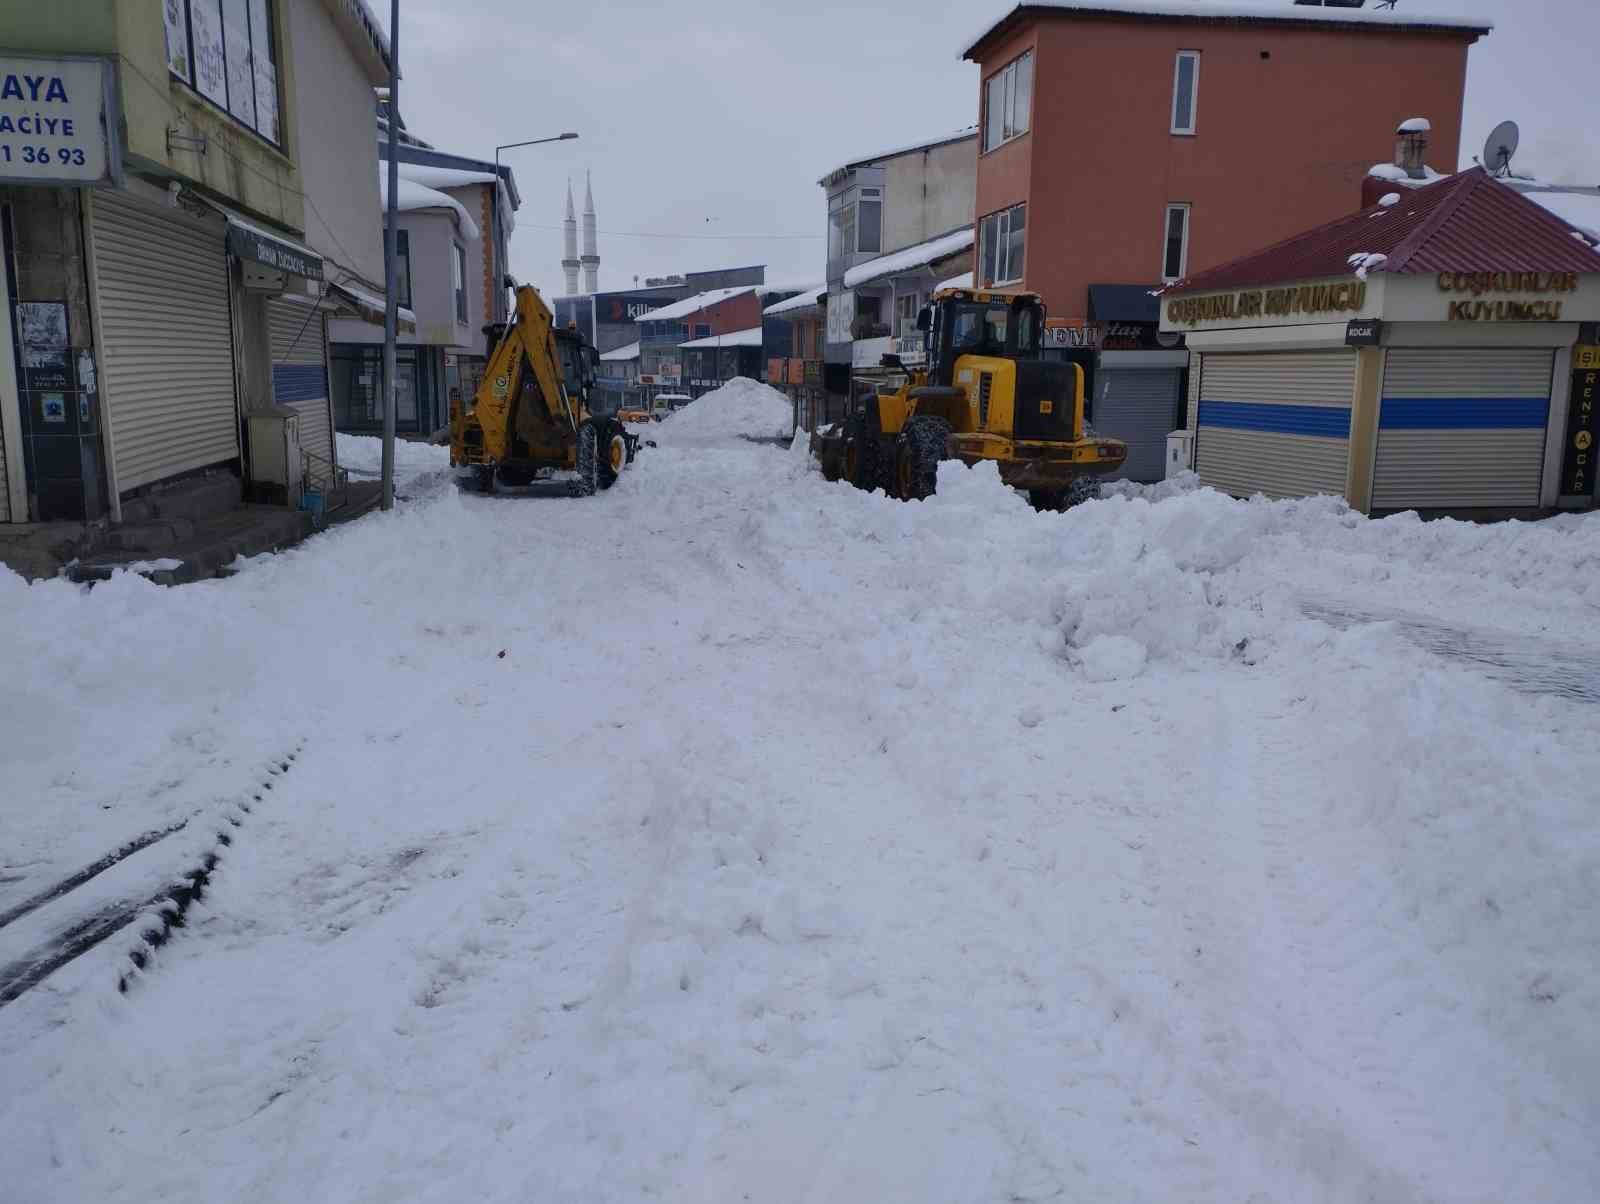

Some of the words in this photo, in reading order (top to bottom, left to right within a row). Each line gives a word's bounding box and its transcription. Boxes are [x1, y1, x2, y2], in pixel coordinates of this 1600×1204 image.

[1, 74, 69, 103] AYA
[0, 112, 74, 136] ACİYE
[22, 146, 50, 164] 36
[58, 147, 86, 166] 93
[1264, 281, 1367, 315] KUYUMCU
[1448, 300, 1562, 321] KUYUMCU
